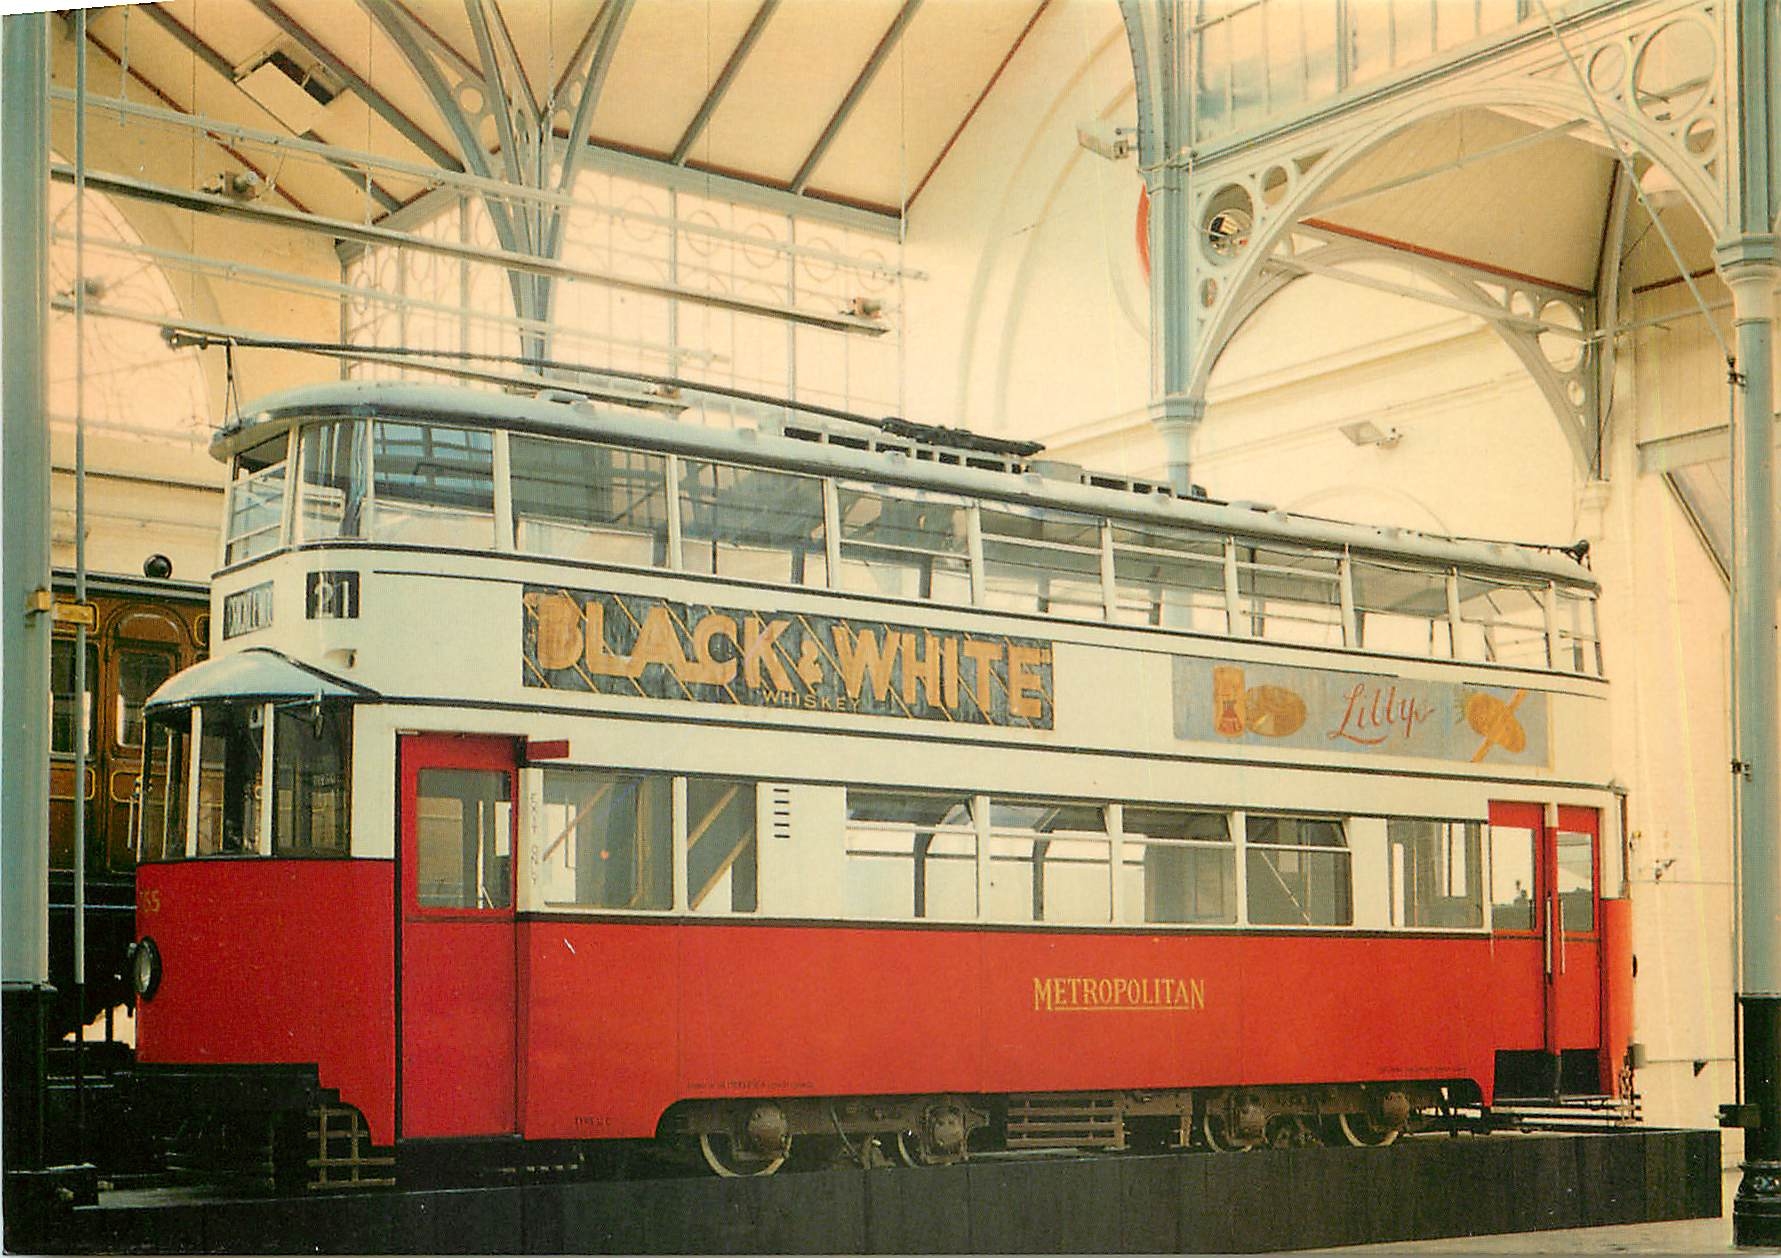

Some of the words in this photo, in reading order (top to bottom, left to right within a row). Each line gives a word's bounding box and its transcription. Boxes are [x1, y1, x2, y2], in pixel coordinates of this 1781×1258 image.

[524, 592, 794, 692] BLACK
[831, 625, 1051, 718] WHITE
[762, 689, 860, 713] WHISKEY
[1033, 977, 1205, 1011] METROPOLITAN
